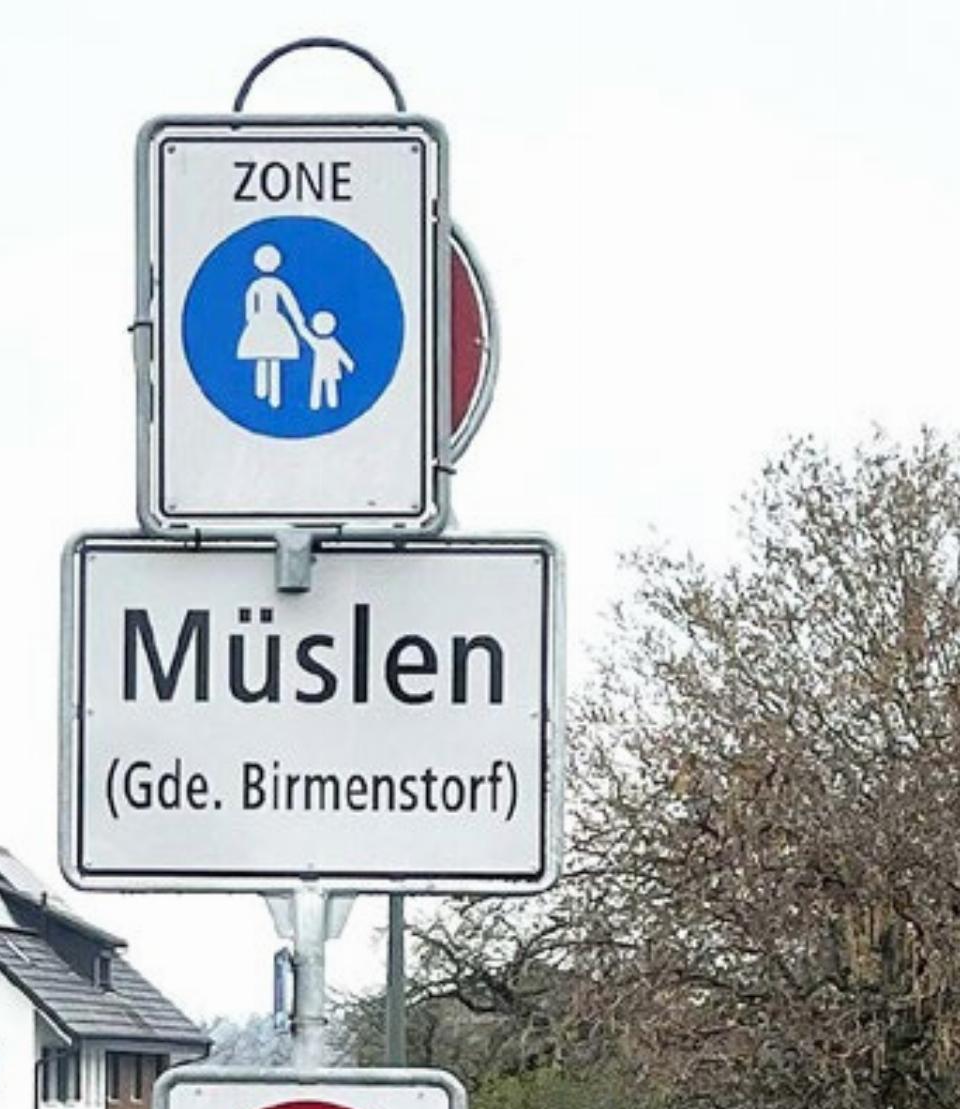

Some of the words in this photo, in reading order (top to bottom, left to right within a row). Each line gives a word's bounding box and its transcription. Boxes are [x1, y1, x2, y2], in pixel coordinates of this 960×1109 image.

[234, 162, 352, 201] ZONE
[124, 603, 503, 705] Müslen
[107, 758, 221, 819] (Gde.
[243, 760, 517, 821] Birmenstorf)
